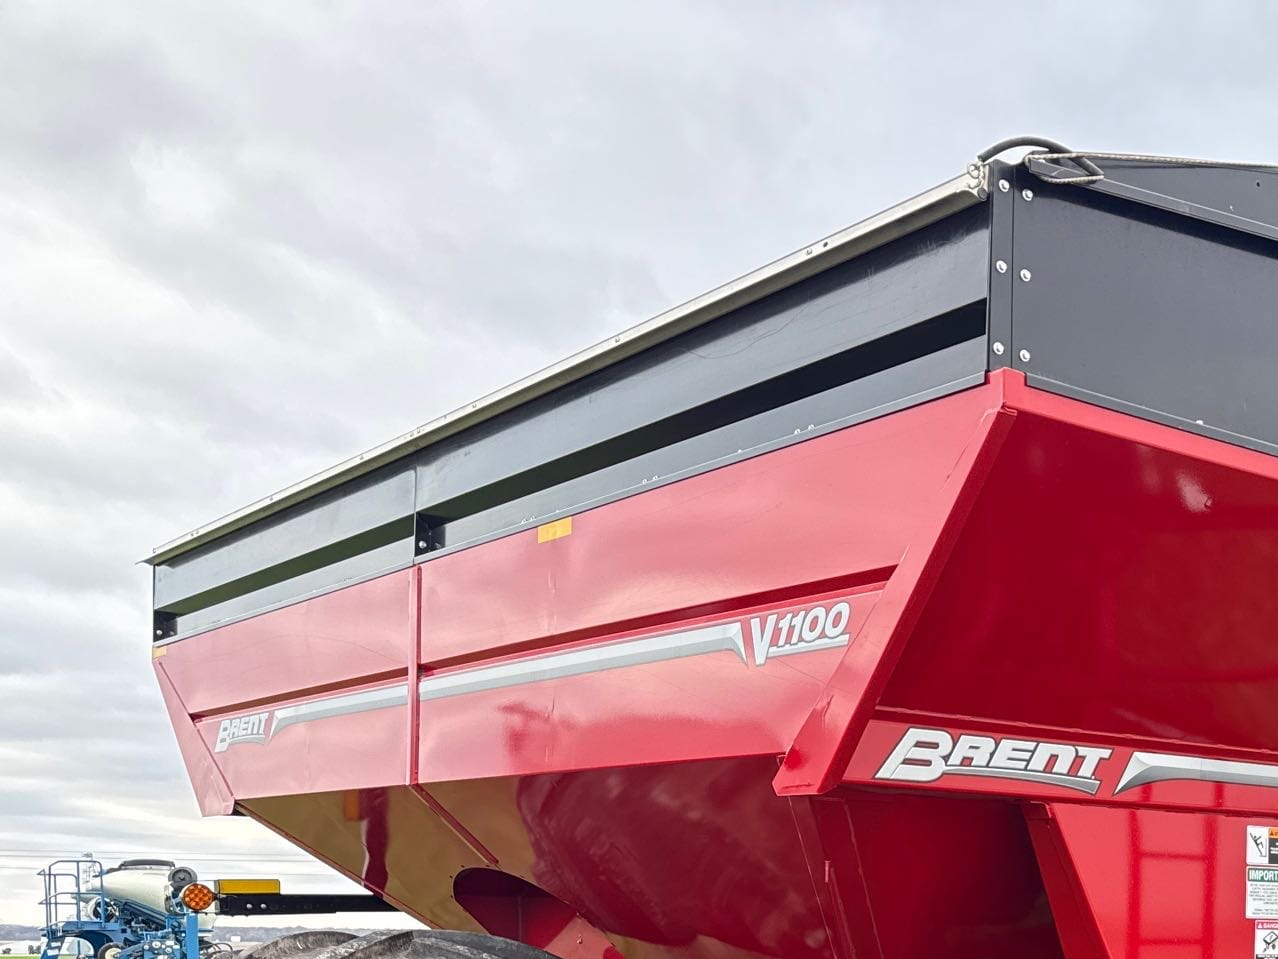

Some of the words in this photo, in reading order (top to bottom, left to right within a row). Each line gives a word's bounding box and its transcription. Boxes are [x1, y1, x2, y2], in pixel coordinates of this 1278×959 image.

[750, 602, 850, 666] V1100
[214, 712, 269, 753] BRENT
[874, 727, 1113, 783] BRENT
